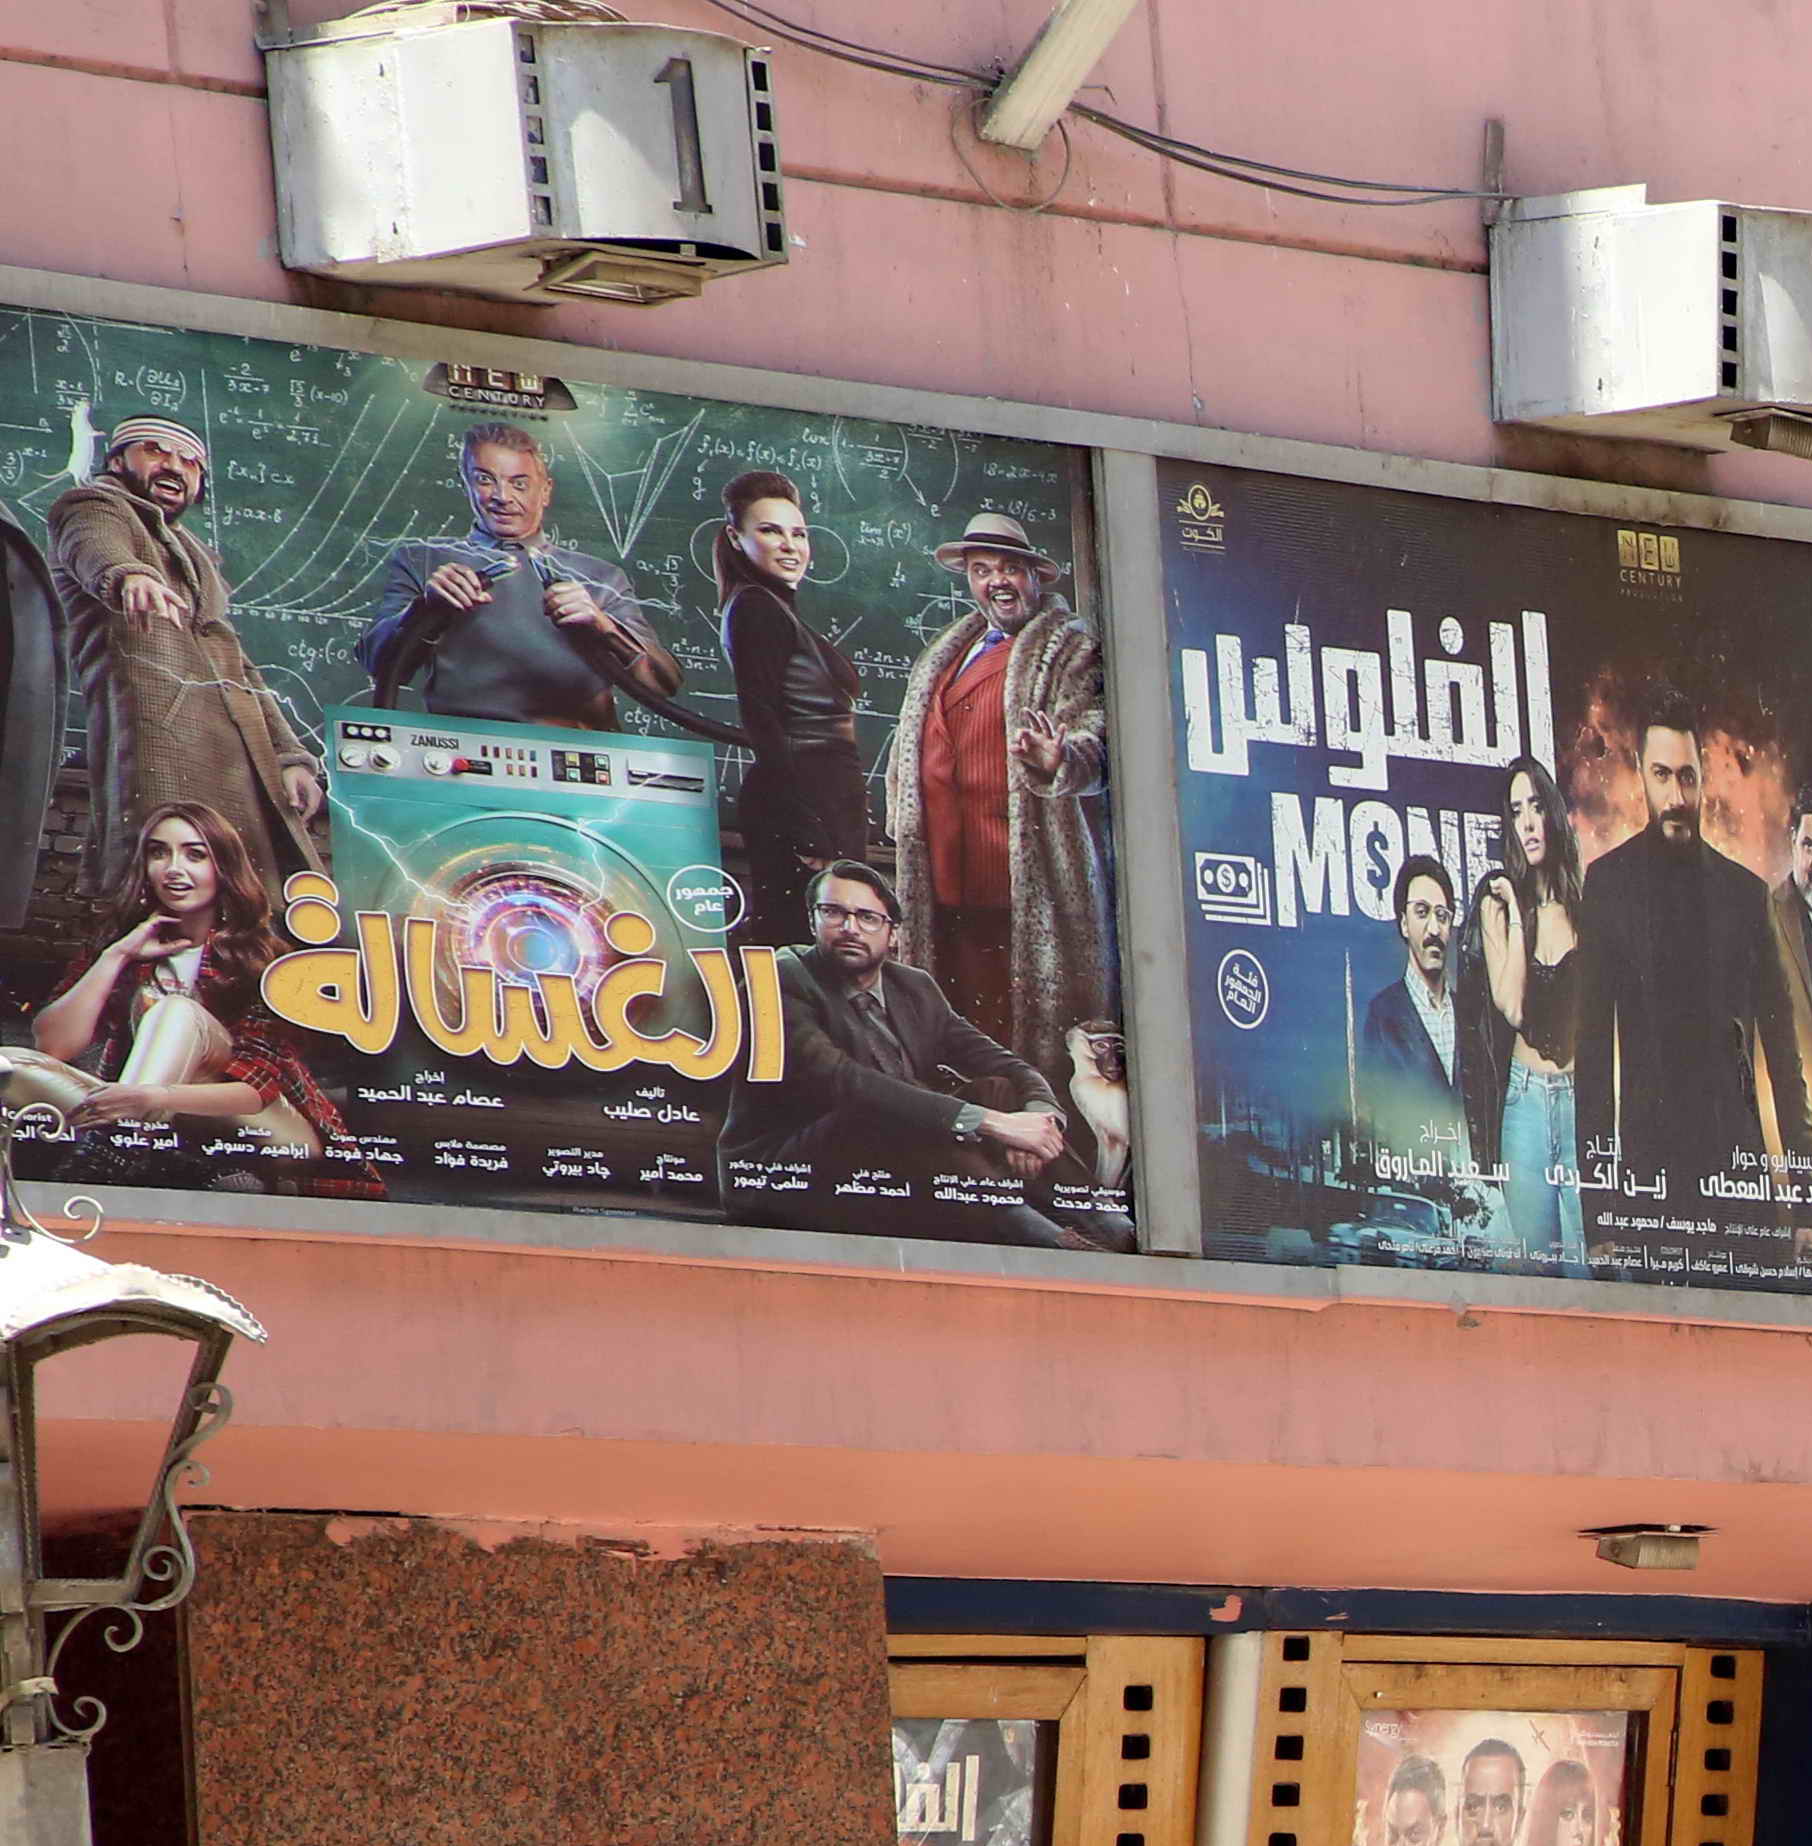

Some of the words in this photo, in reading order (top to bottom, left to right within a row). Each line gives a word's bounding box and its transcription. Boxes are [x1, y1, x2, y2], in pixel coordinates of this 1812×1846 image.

[653, 57, 714, 213] 1
[448, 385, 546, 409] CENTURY
[1619, 571, 1683, 588] CENTURY
[1181, 609, 1558, 791] الفلوس
[411, 734, 460, 751] ZANUSSI
[675, 884, 735, 901] جمهور
[694, 900, 725, 916] عام
[261, 871, 785, 1082] الغسالة
[357, 1085, 412, 1102] الحميد
[416, 1087, 447, 1105] عبد
[452, 1090, 505, 1108] عصام
[603, 1102, 651, 1121] صليب
[657, 1101, 701, 1122] عادل
[1730, 1144, 1758, 1171] حوار
[667, 1168, 703, 1183] محمد
[1447, 1158, 1510, 1182] سعيد
[1623, 1169, 1667, 1200] زين
[1773, 1179, 1802, 1208] عبد
